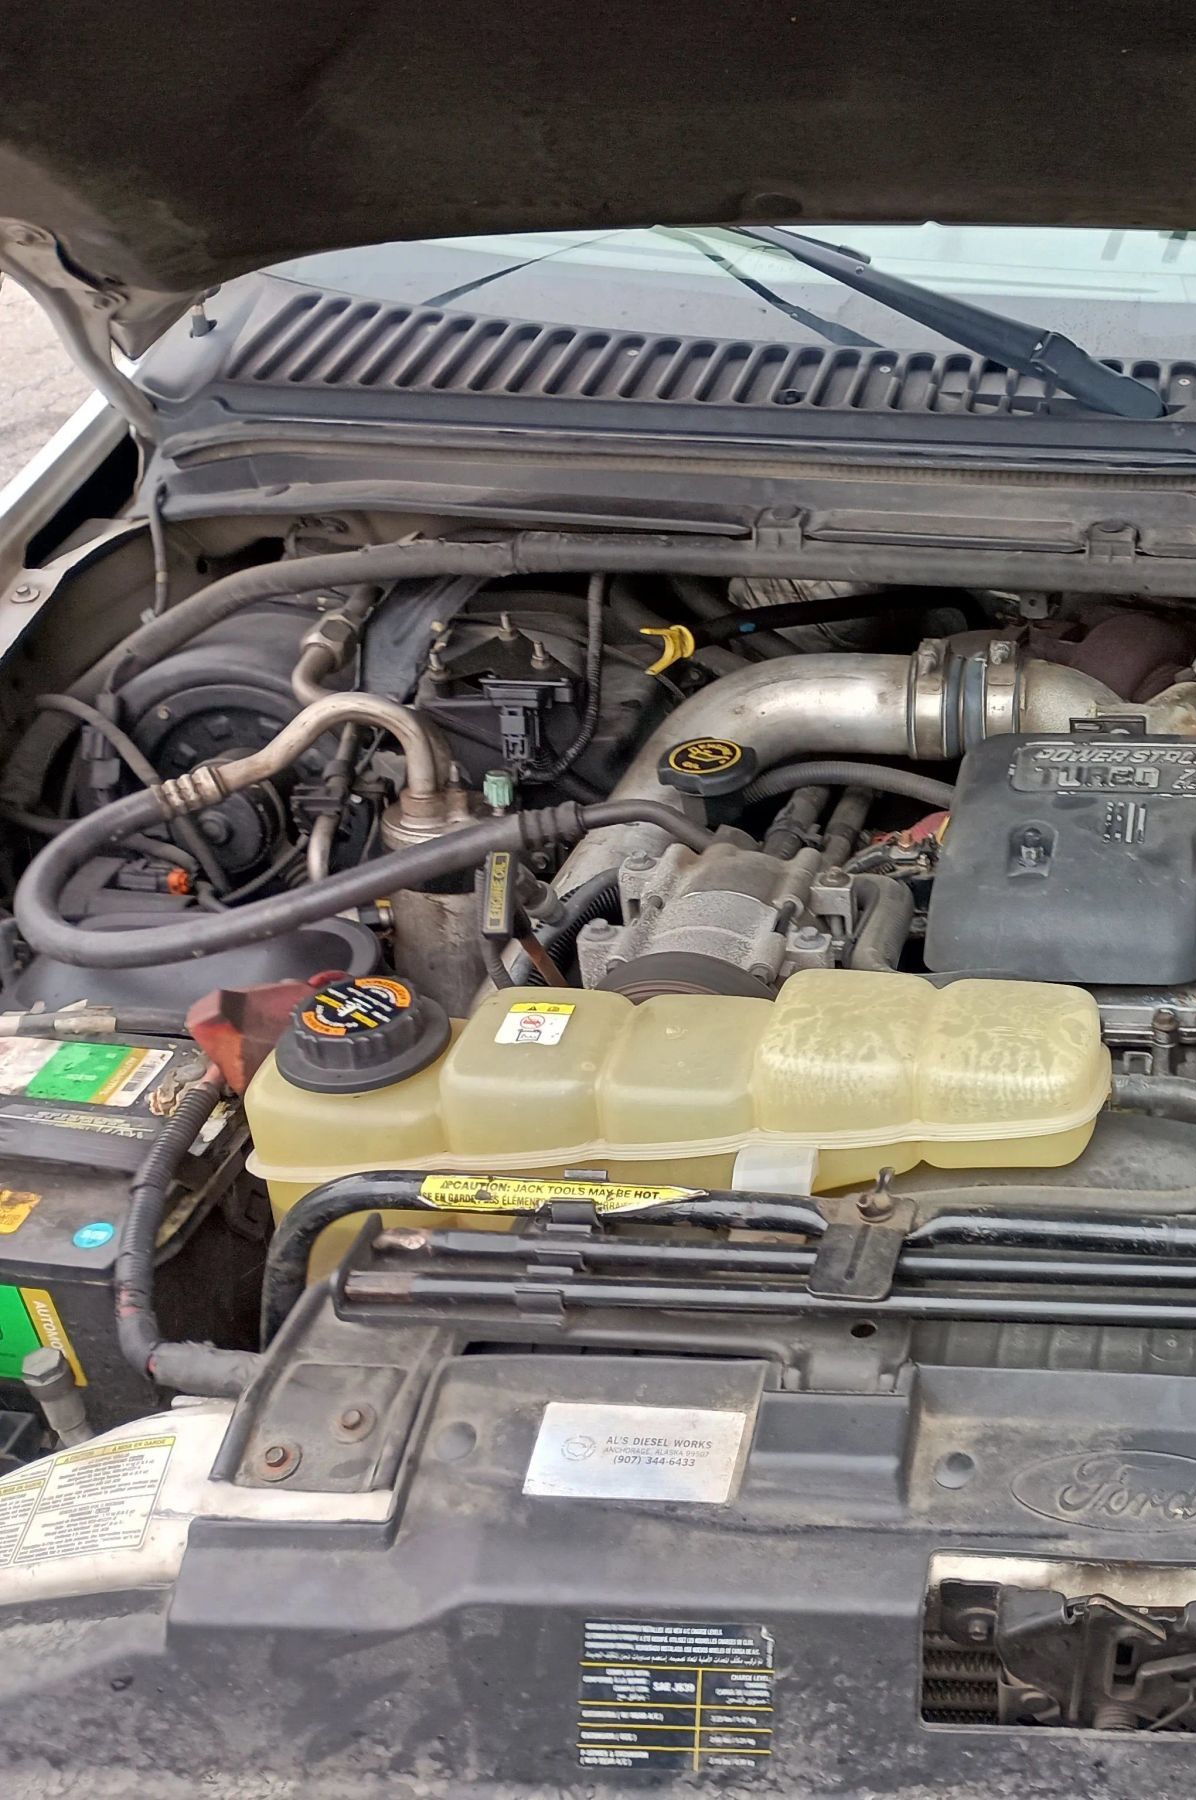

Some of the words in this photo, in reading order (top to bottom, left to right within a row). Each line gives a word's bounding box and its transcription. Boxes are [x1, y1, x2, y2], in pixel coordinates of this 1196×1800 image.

[453, 1180, 511, 1192] CAUTION:
[513, 1184, 544, 1194] JACK
[549, 1186, 586, 1196] TOOLS
[615, 1189, 631, 1199] BE
[606, 1436, 630, 1445] AL'S
[633, 1437, 669, 1448] DIESEL
[673, 1439, 713, 1450] WORKS
[654, 1448, 684, 1457] ALASKA
[613, 1455, 642, 1465] (907)
[645, 1456, 696, 1467] 344-6433
